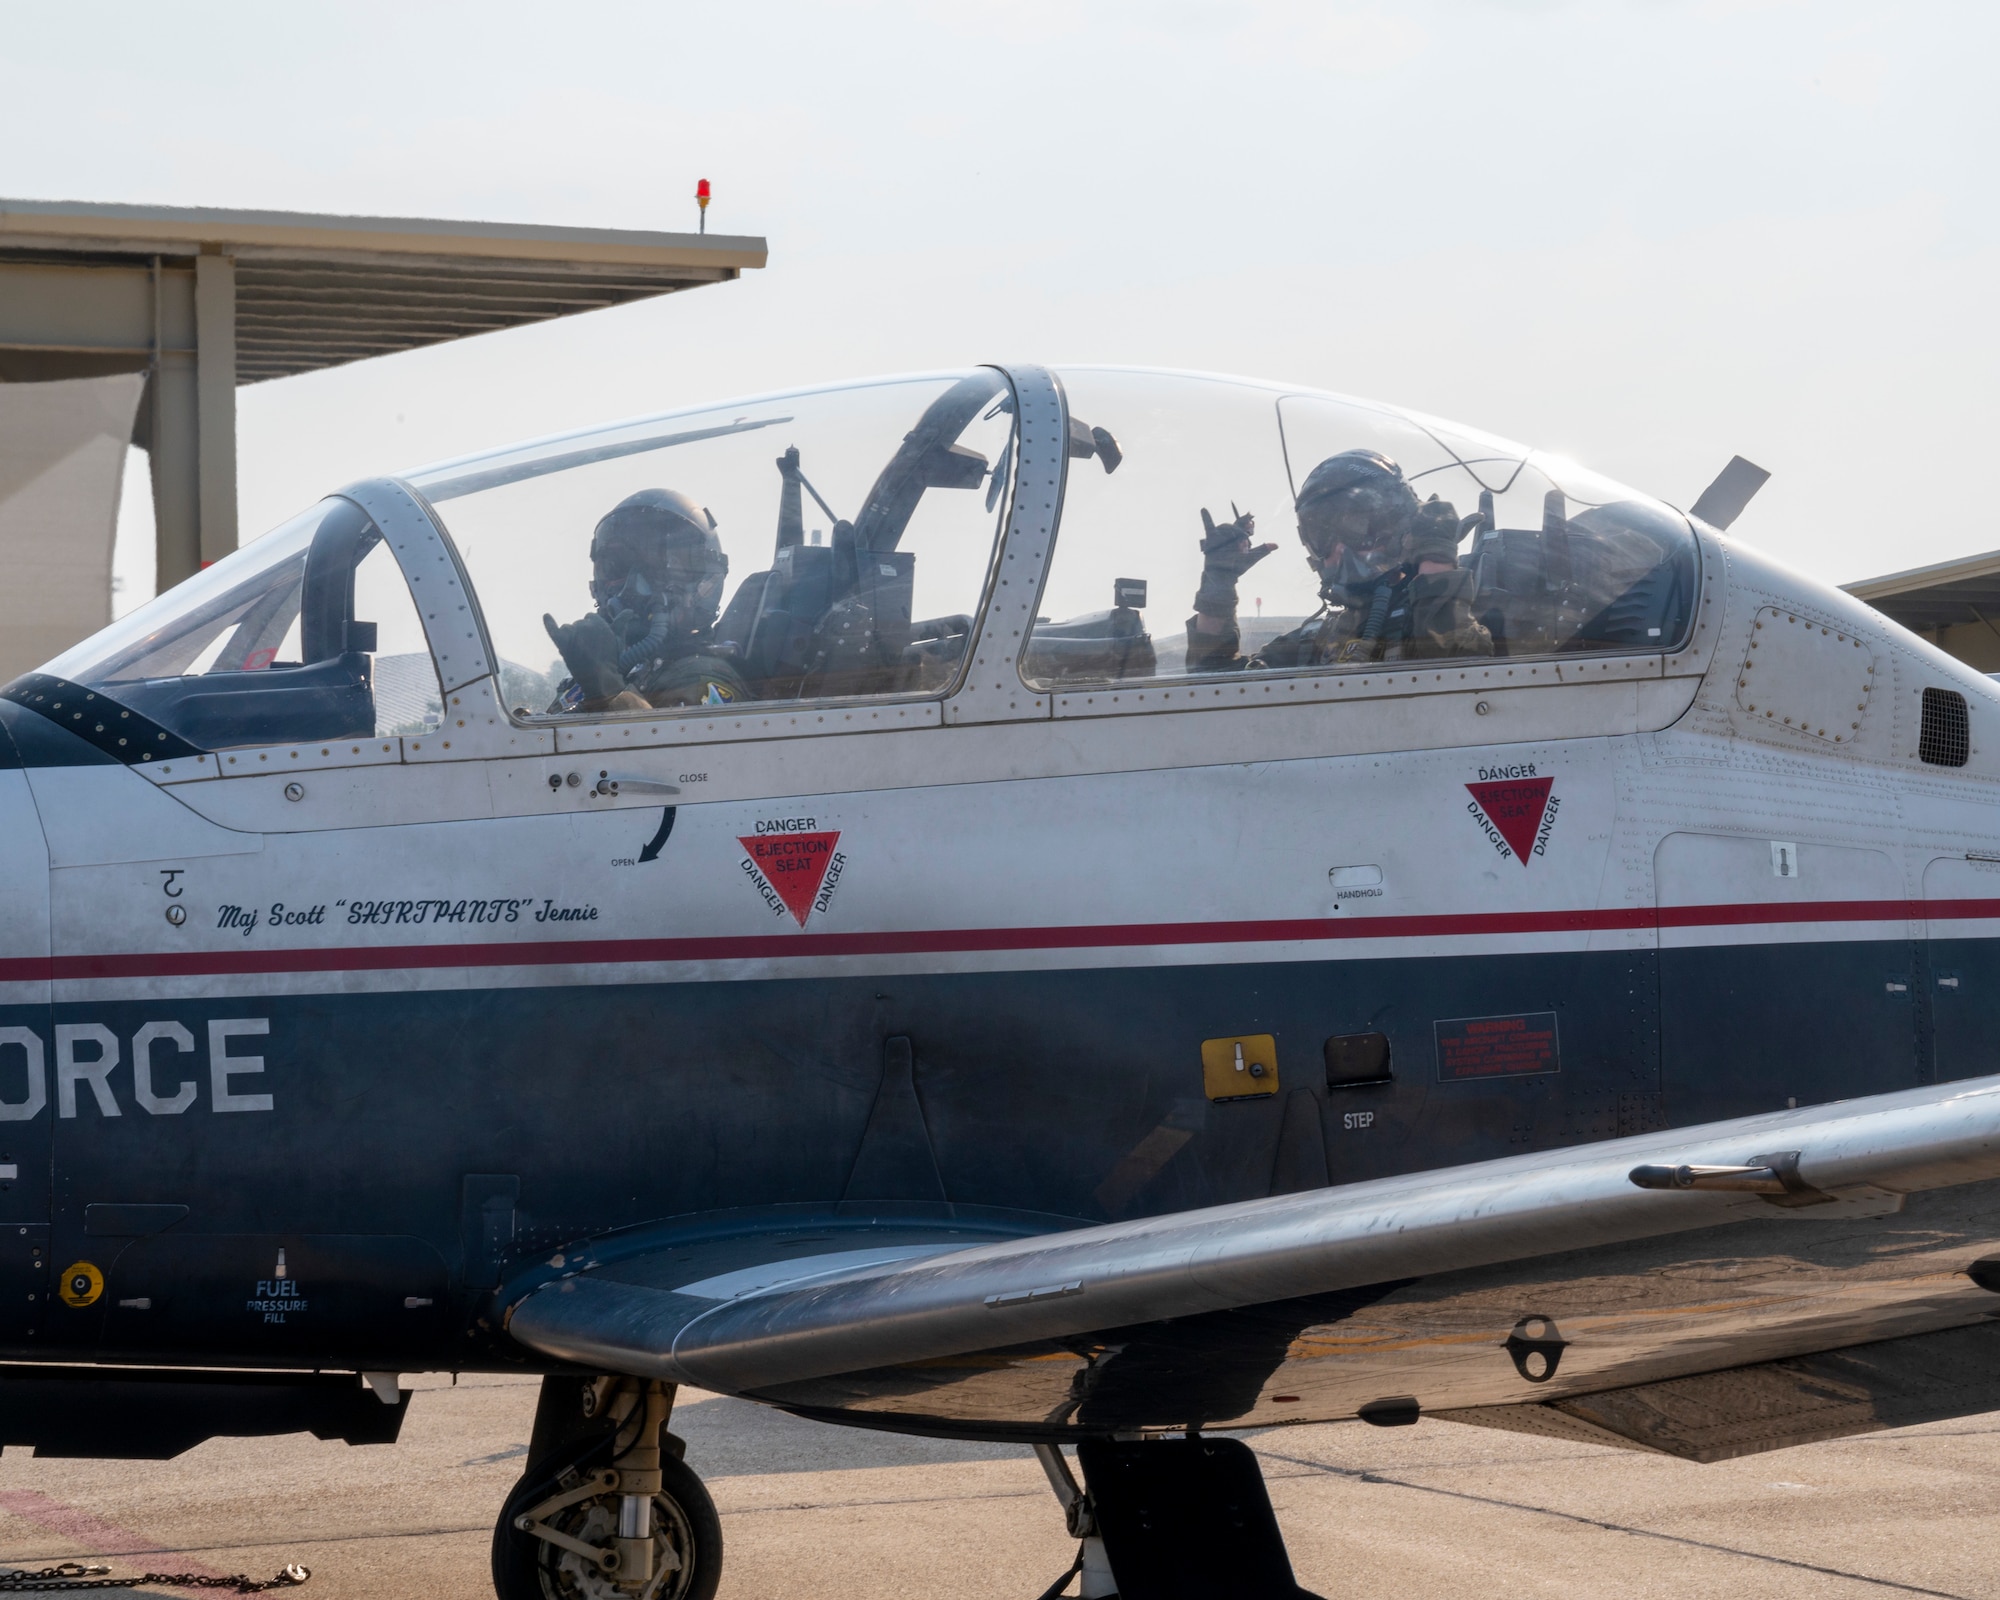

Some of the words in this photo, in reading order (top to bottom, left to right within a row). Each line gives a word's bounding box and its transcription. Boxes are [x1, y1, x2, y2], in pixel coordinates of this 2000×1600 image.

[679, 773, 708, 783] CLOSE
[1479, 765, 1537, 781] DANGER
[1480, 786, 1546, 803] EJECTION
[1500, 804, 1531, 818] SEAT
[756, 818, 817, 833] DANGER
[1467, 801, 1512, 860] DANGER
[1534, 796, 1561, 856] DANGER
[755, 840, 828, 857] EJECTION
[611, 859, 635, 867] OPEN
[776, 858, 812, 872] SEAT
[741, 858, 786, 916] DANGER
[815, 852, 847, 913] DANGER
[1337, 889, 1383, 900] HANDHOLD
[217, 904, 258, 937] Maj
[268, 902, 326, 927] Scott
[535, 899, 600, 923] Jennie
[1466, 1019, 1525, 1034] WARNING
[1343, 1111, 1374, 1130] STEP
[256, 1280, 300, 1297] FUEL
[246, 1300, 308, 1312] PRESSURE
[264, 1312, 286, 1323] FILL
